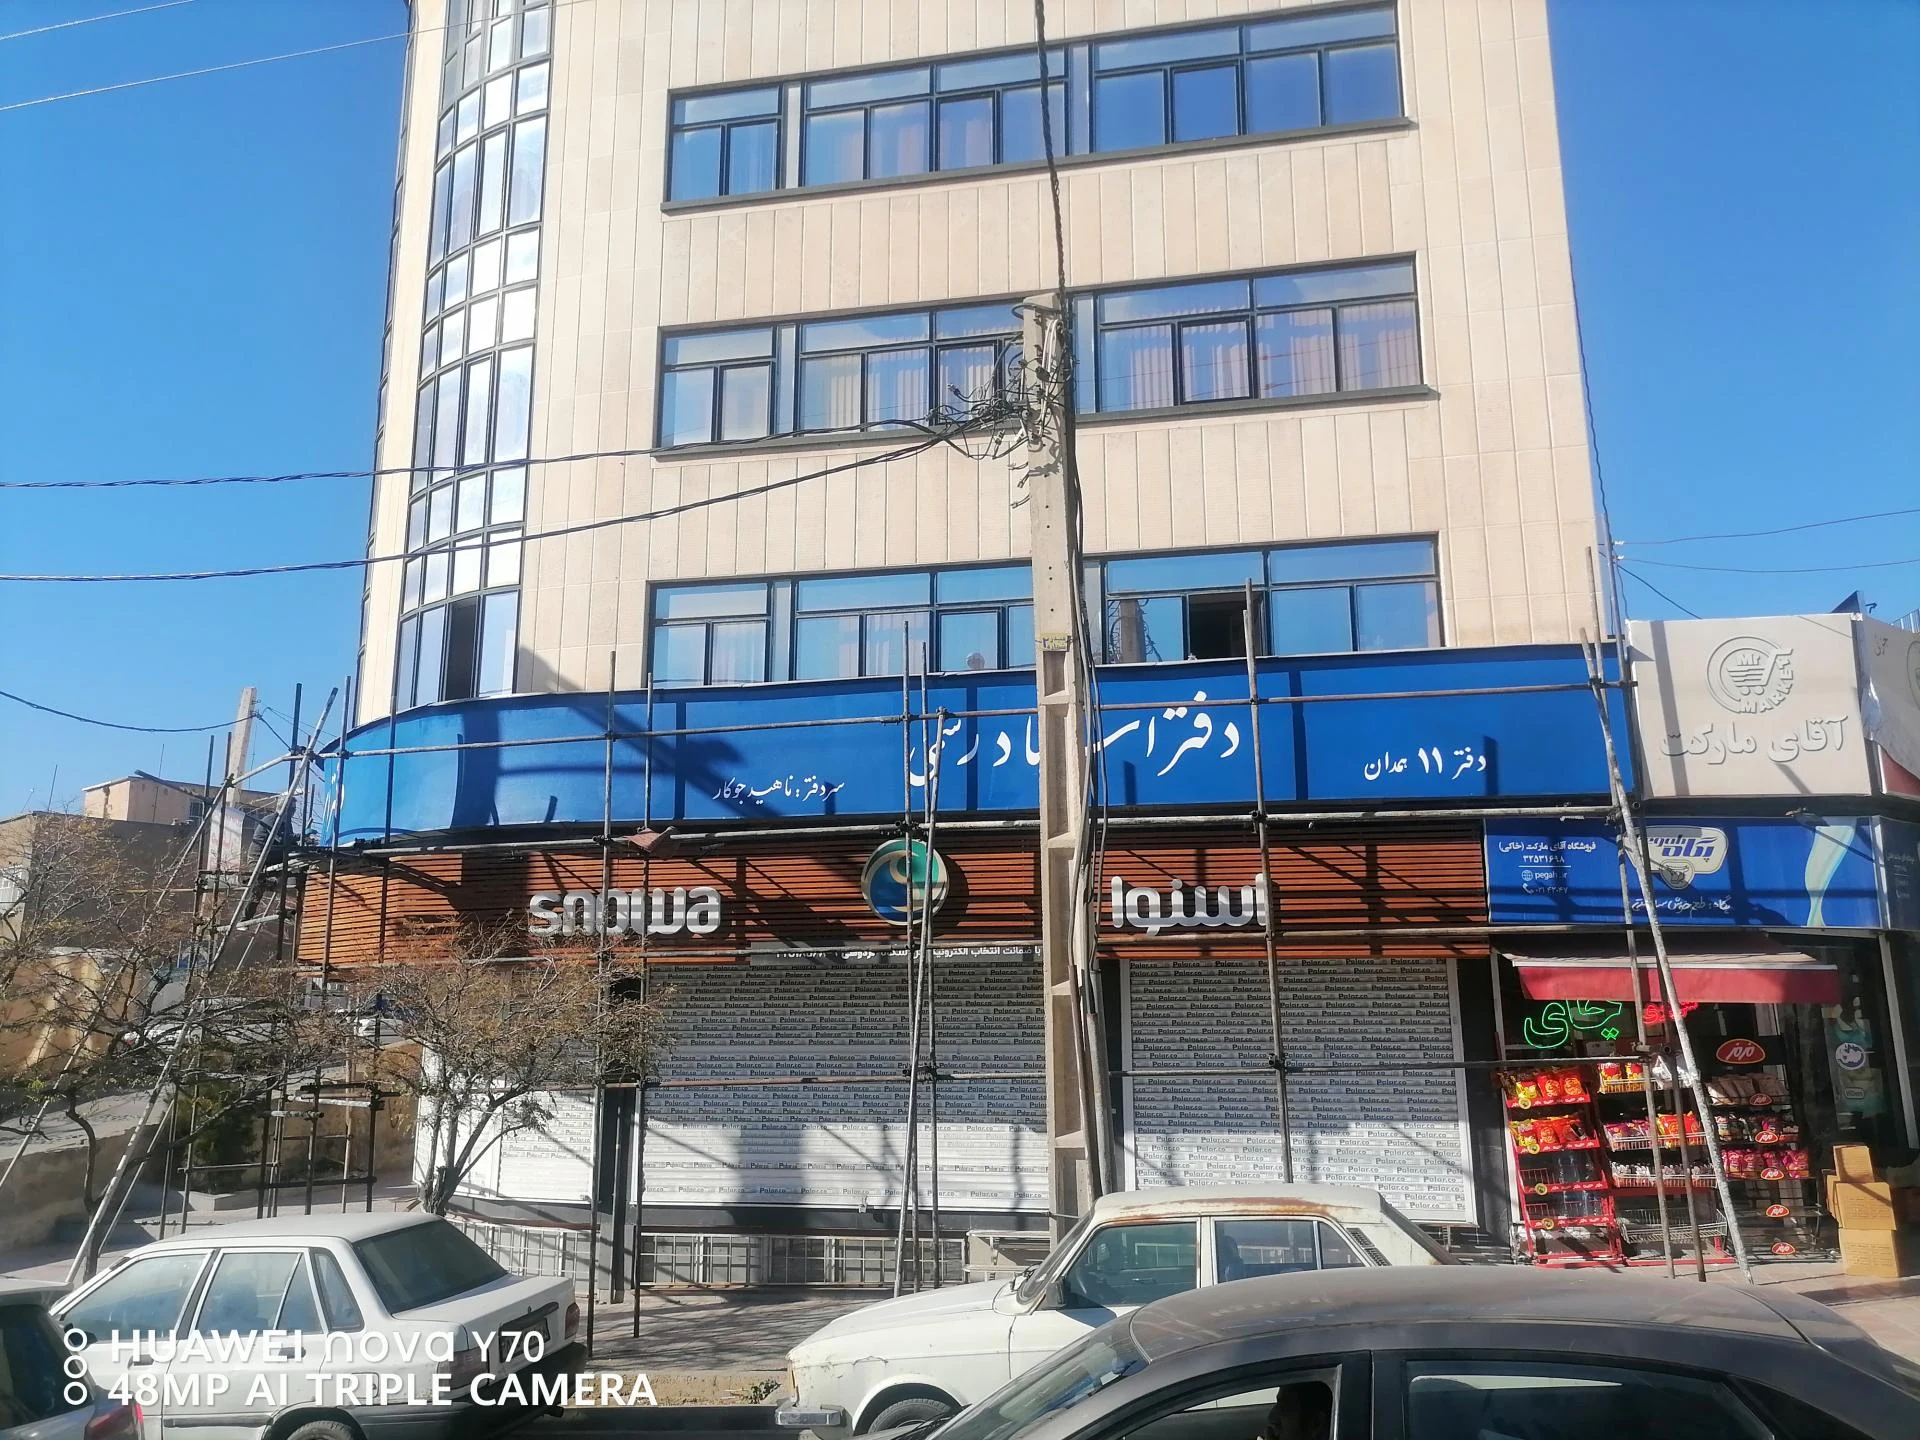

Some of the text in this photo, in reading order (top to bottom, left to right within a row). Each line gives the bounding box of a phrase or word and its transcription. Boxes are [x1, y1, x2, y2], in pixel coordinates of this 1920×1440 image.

[1736, 653, 1762, 667] Mr
[1157, 690, 1240, 777] دفتر
[1660, 713, 1849, 766] آقای مارکت
[1363, 746, 1487, 781] دفتر ۱۱ همدان
[1525, 842, 1548, 852] مارکت
[1567, 841, 1597, 853] فروشگاه
[528, 886, 721, 937] snowa
[1111, 872, 1270, 937] اسنوا
